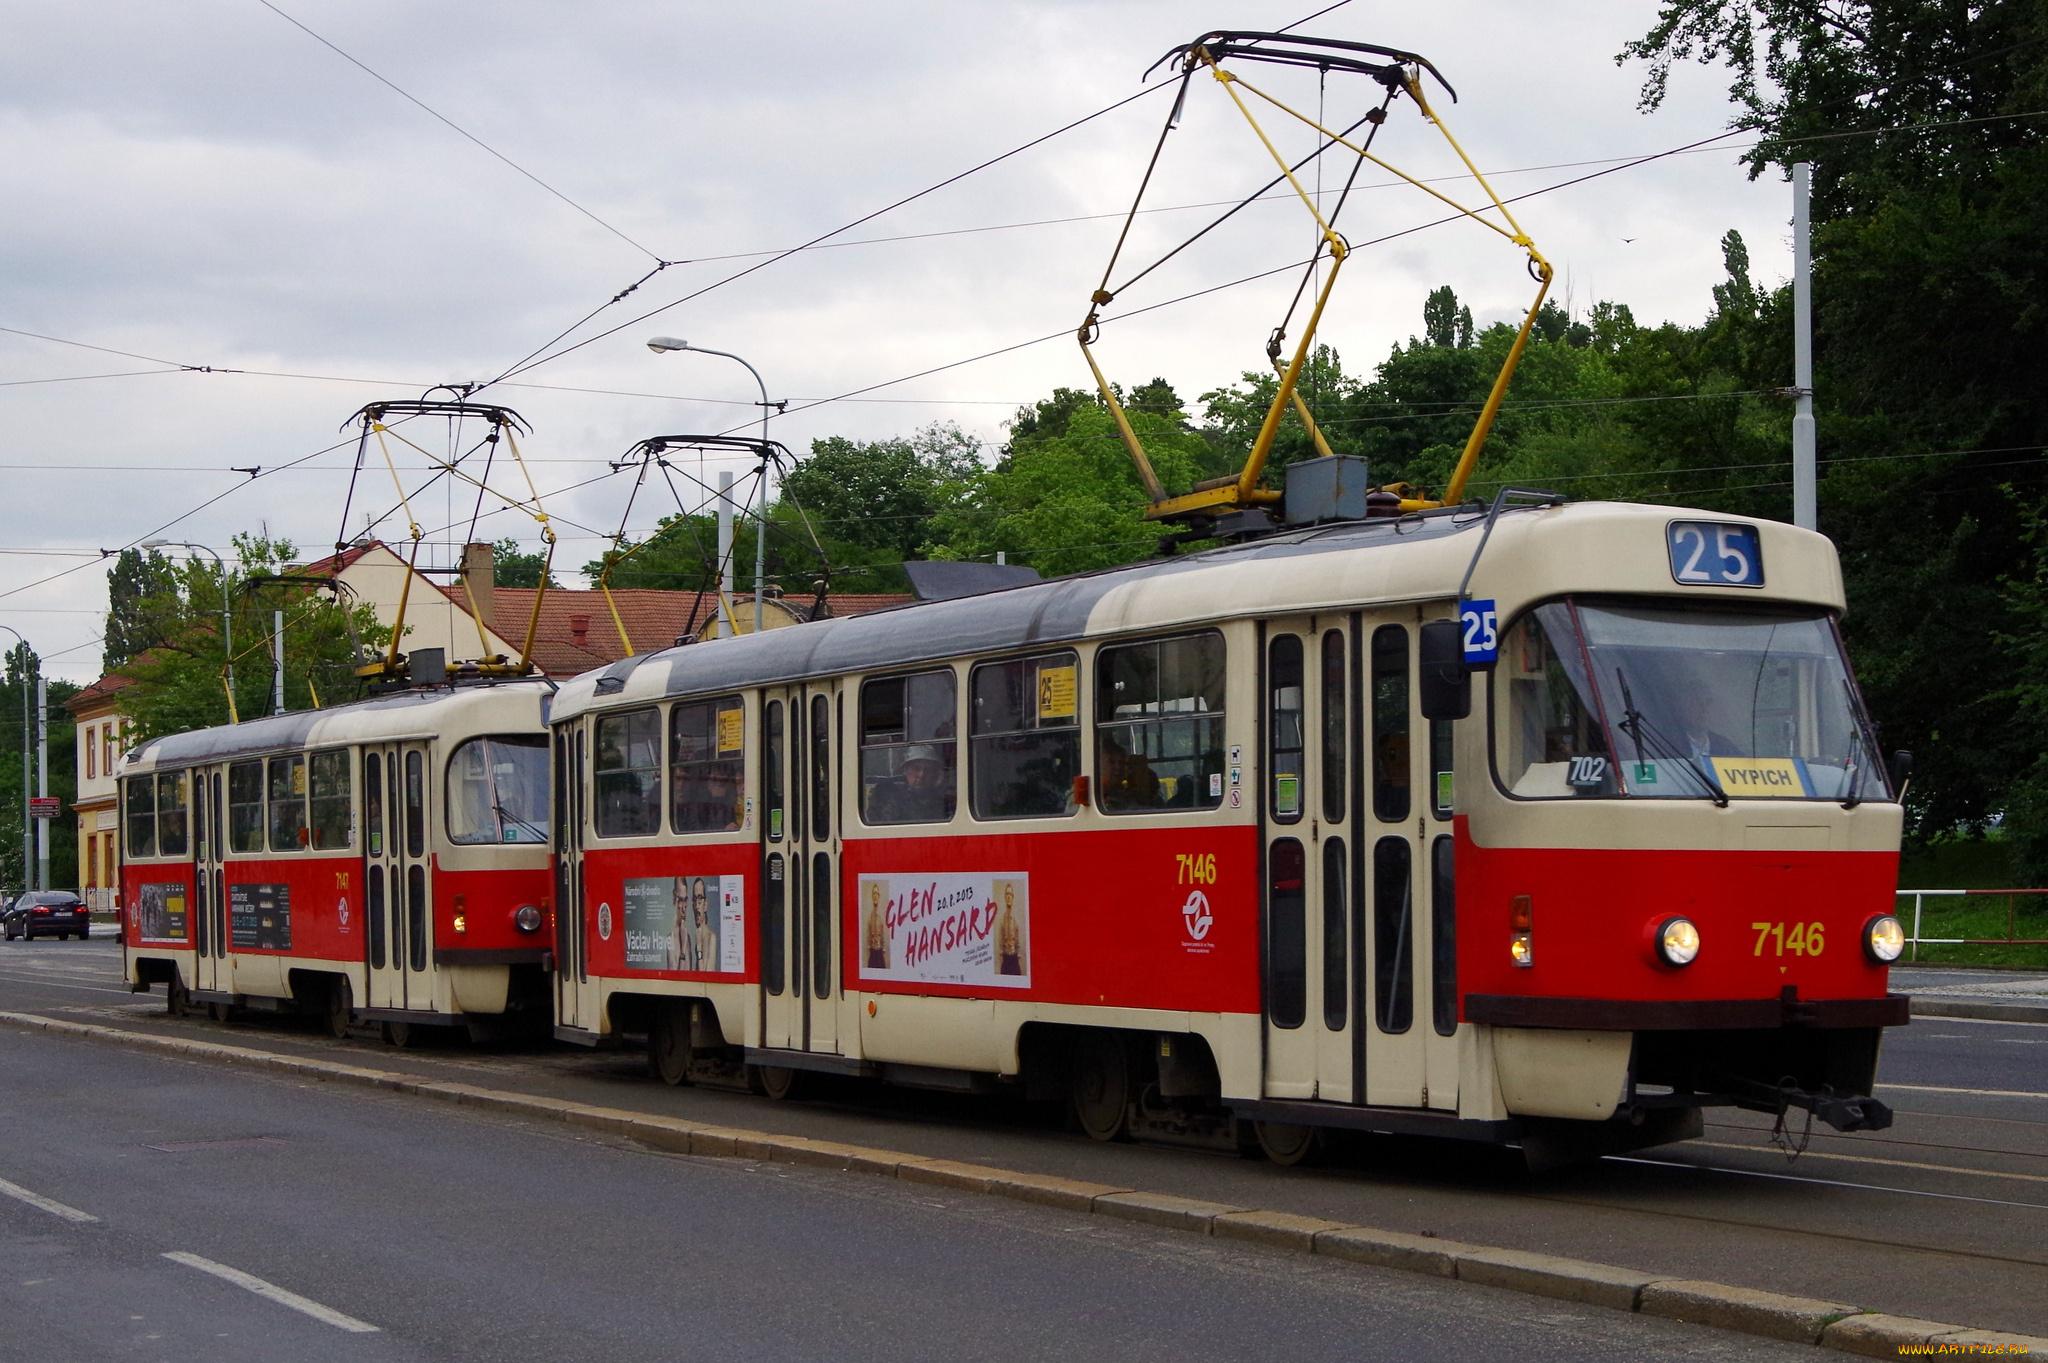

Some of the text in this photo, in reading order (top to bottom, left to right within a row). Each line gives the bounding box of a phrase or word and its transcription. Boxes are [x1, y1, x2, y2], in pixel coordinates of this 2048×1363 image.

[1674, 523, 1750, 584] 25
[1461, 611, 1497, 652] 25
[1570, 756, 1606, 781] 702
[1723, 768, 1793, 787] VYPICH
[1175, 853, 1217, 885] 7146
[884, 881, 937, 940] GLEN
[626, 930, 675, 951] Václav Havel
[905, 897, 998, 968] HANSARD
[1752, 922, 1825, 957] 7146
